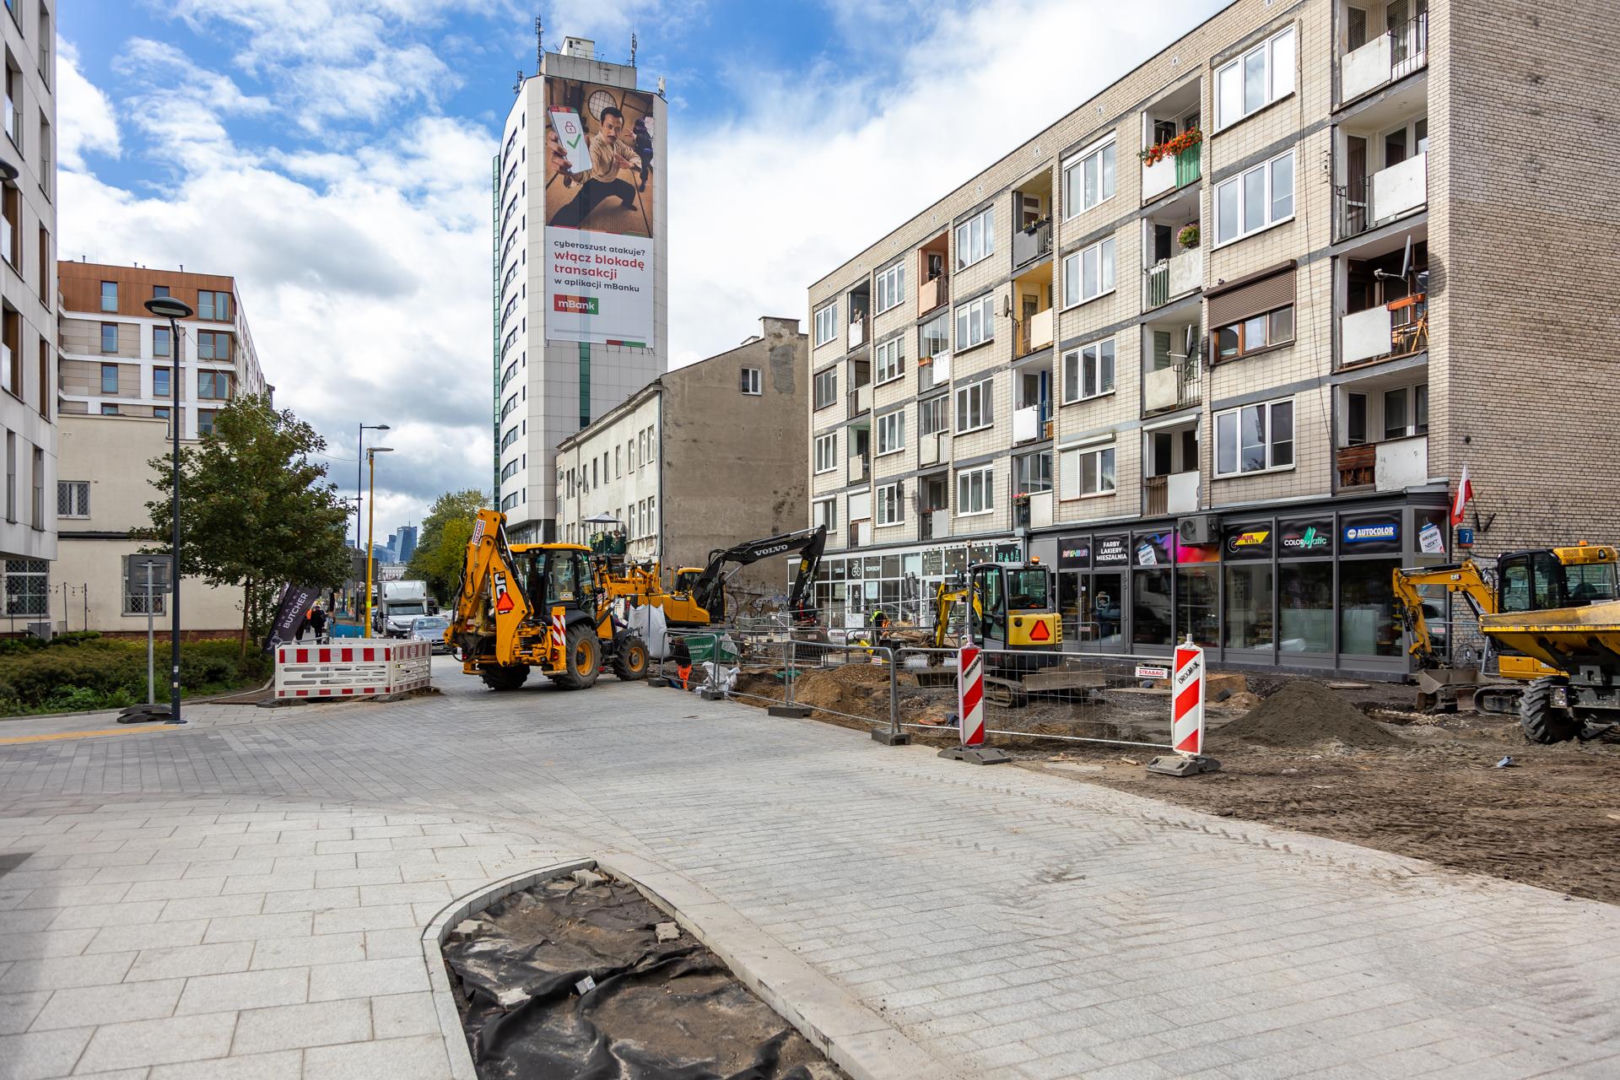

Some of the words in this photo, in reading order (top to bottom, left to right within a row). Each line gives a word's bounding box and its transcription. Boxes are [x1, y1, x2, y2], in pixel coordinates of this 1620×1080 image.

[554, 240, 607, 252] cyberoszust
[609, 246, 645, 256] atakuje?
[554, 251, 591, 264] włącz
[595, 254, 645, 271] blokadę
[554, 264, 617, 280] transakcji
[564, 279, 602, 289] aplikacji
[604, 283, 640, 292] mBanku
[558, 300, 595, 310] mBank
[1357, 527, 1394, 537] AUTOCOLOR
[754, 544, 788, 556] VOLVO
[283, 592, 308, 629] BUTCHER
